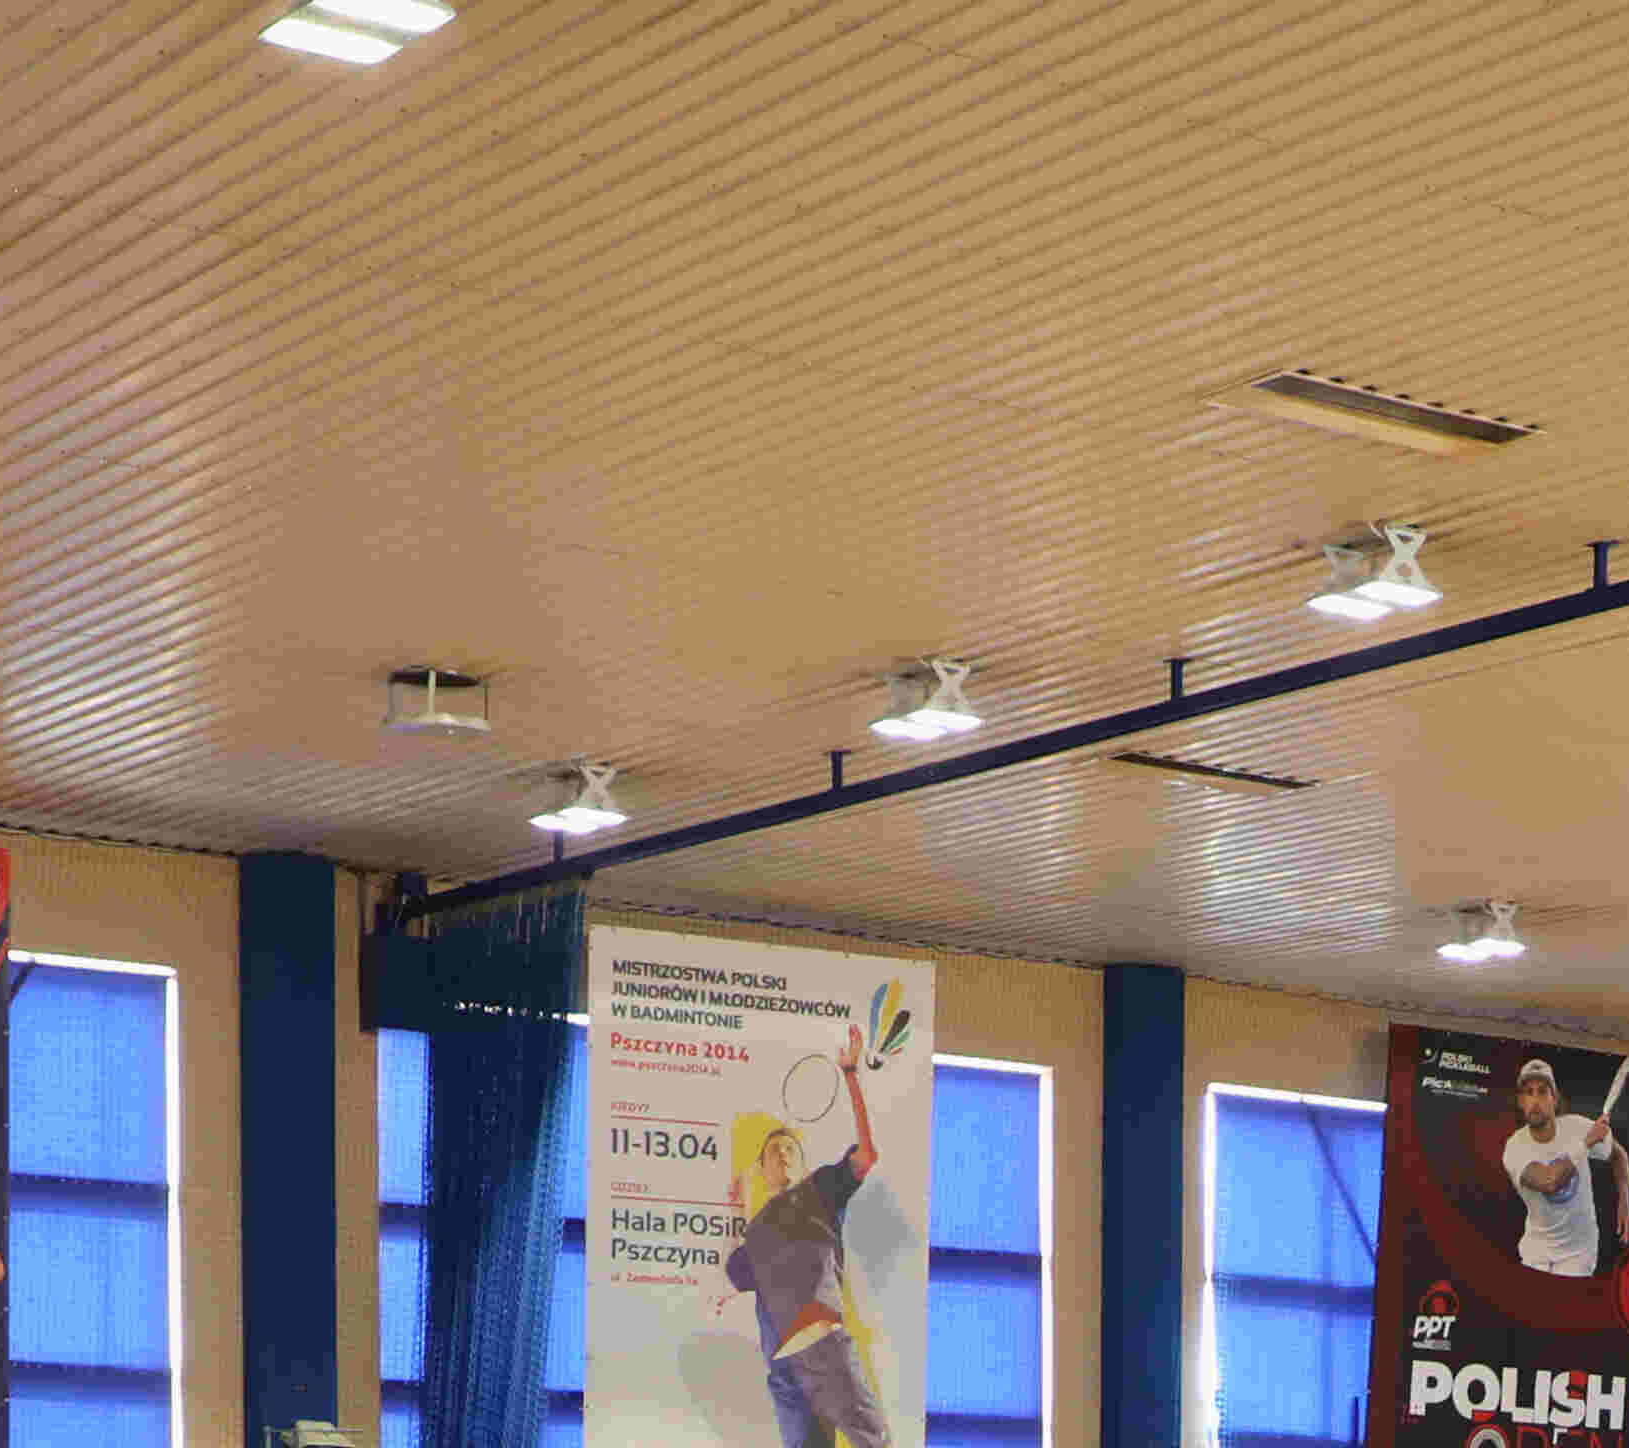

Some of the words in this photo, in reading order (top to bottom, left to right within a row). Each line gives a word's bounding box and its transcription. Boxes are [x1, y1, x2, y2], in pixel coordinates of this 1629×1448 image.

[612, 960, 730, 985] MISTRZOSTWA
[731, 972, 788, 991] POLSKI
[612, 980, 699, 1003] JUNIORÓW
[708, 990, 852, 1019] MŁODZIEŻOWCÓW
[612, 1003, 628, 1018] W
[629, 1004, 744, 1030] BADMINTONIE
[611, 1031, 699, 1058] Pszczyna
[703, 1041, 750, 1063] 2014
[611, 1127, 719, 1161] 11-13.04
[611, 1207, 666, 1233] Hala
[674, 1212, 748, 1240] POSiR
[611, 1238, 720, 1269] Pszczyna
[1412, 1315, 1457, 1339] PPT
[1409, 1360, 1627, 1430] POLISH
